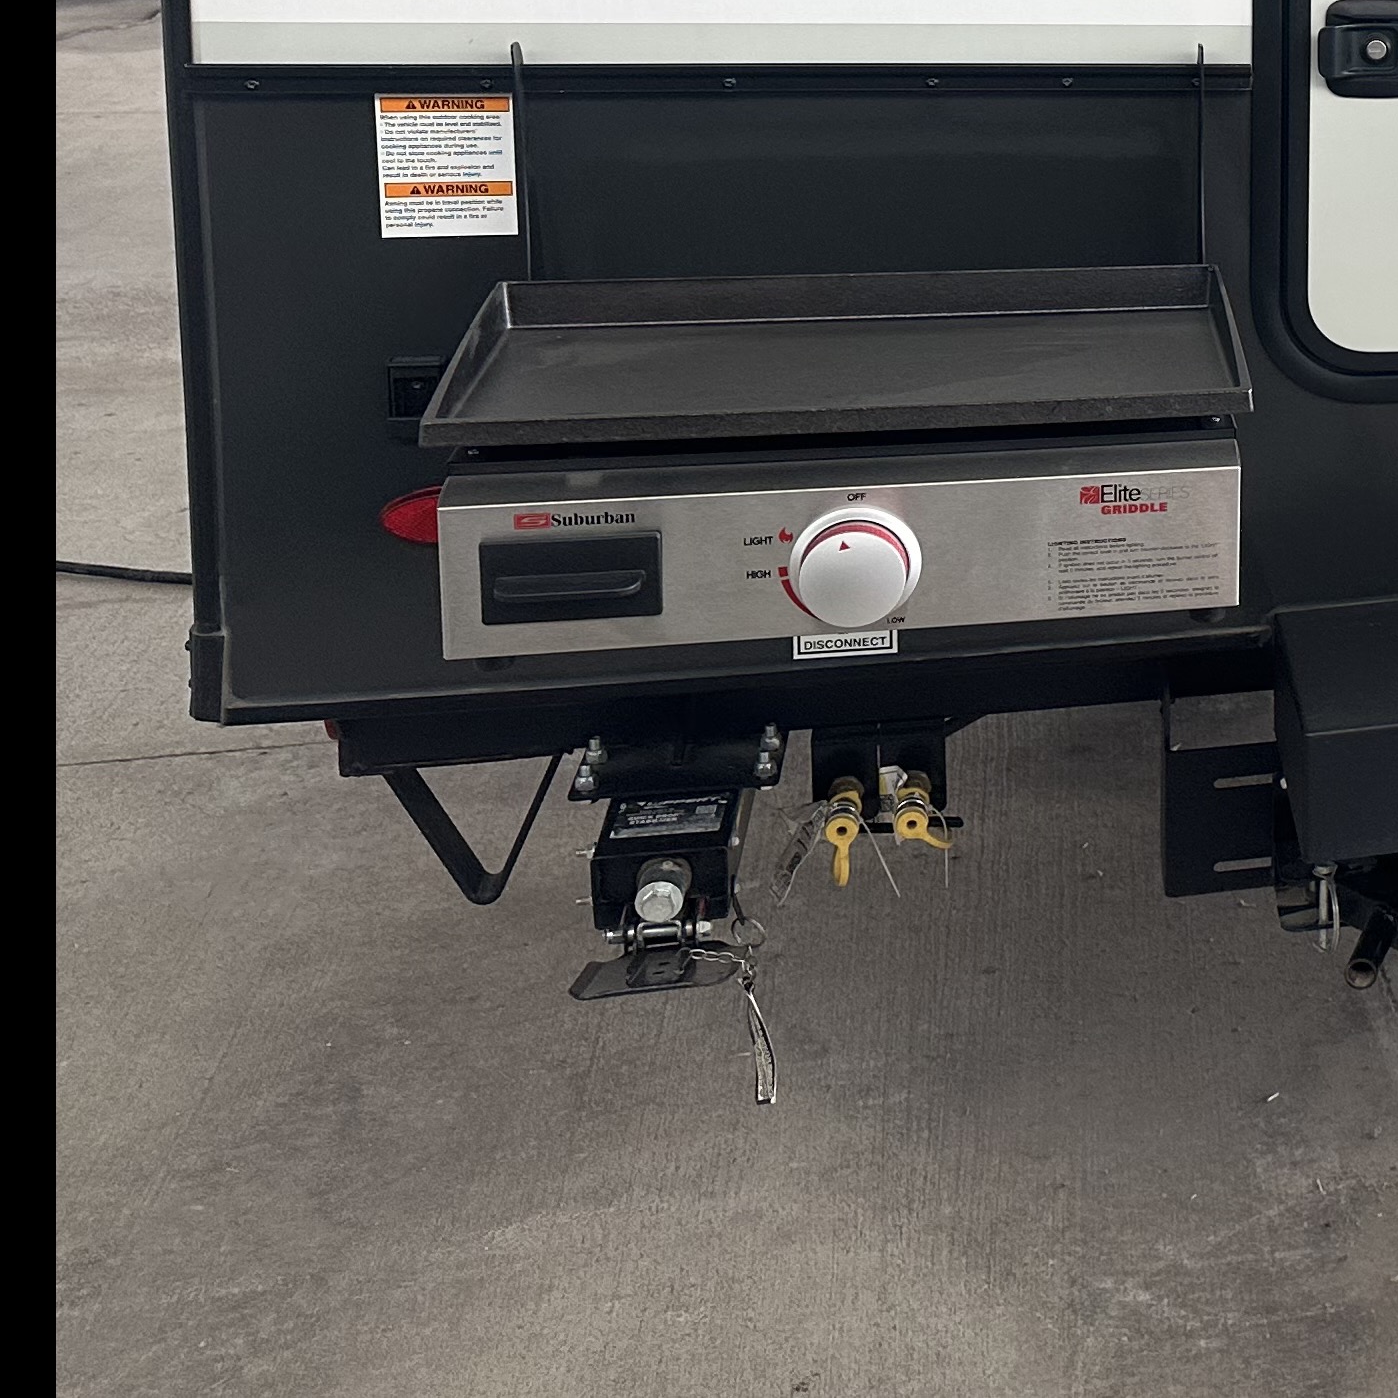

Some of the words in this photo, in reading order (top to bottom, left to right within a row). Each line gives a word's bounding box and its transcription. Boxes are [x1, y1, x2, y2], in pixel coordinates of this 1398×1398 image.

[418, 99, 485, 110] WARNING
[423, 183, 489, 194] WARNING
[847, 493, 867, 502] OFF
[1101, 483, 1141, 503] Elite
[1141, 485, 1190, 500] SERIES
[1101, 502, 1168, 515] GRIDDLE
[551, 511, 636, 527] Suburban
[743, 536, 774, 546] LIGHT
[746, 569, 772, 580] HIGH
[886, 616, 906, 624] LOW
[803, 636, 887, 651] DISCONNECT
